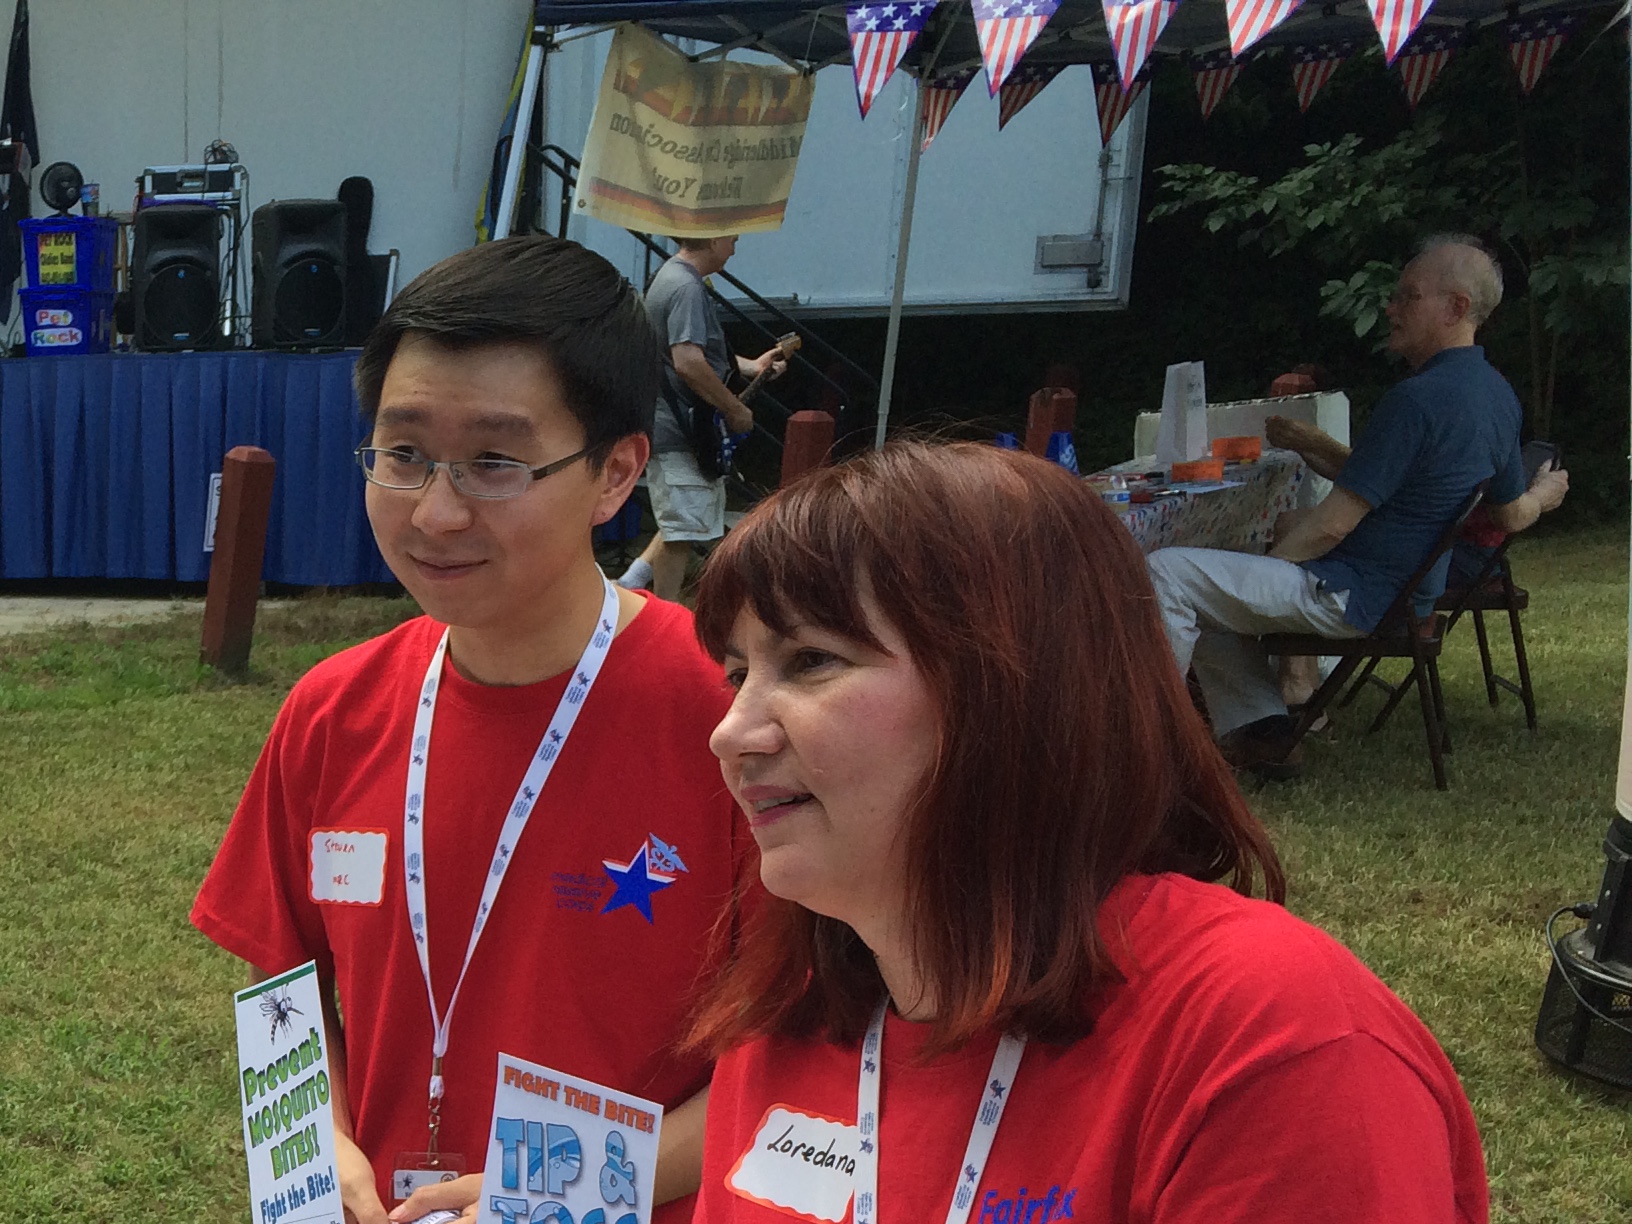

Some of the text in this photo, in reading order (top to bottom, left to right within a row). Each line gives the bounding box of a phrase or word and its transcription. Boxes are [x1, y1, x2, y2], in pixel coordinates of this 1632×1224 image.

[31, 329, 82, 347] Rock
[35, 310, 71, 327] Pet
[242, 1027, 323, 1106] Prevent
[247, 1070, 330, 1149] MOSQUITO
[504, 1065, 655, 1135] FIGHT THE BITE!
[270, 1122, 321, 1180] BITES!
[495, 1116, 638, 1206] TIP &
[767, 1124, 856, 1178] Loredana
[287, 1184, 306, 1212] the
[306, 1165, 336, 1202] Bite!
